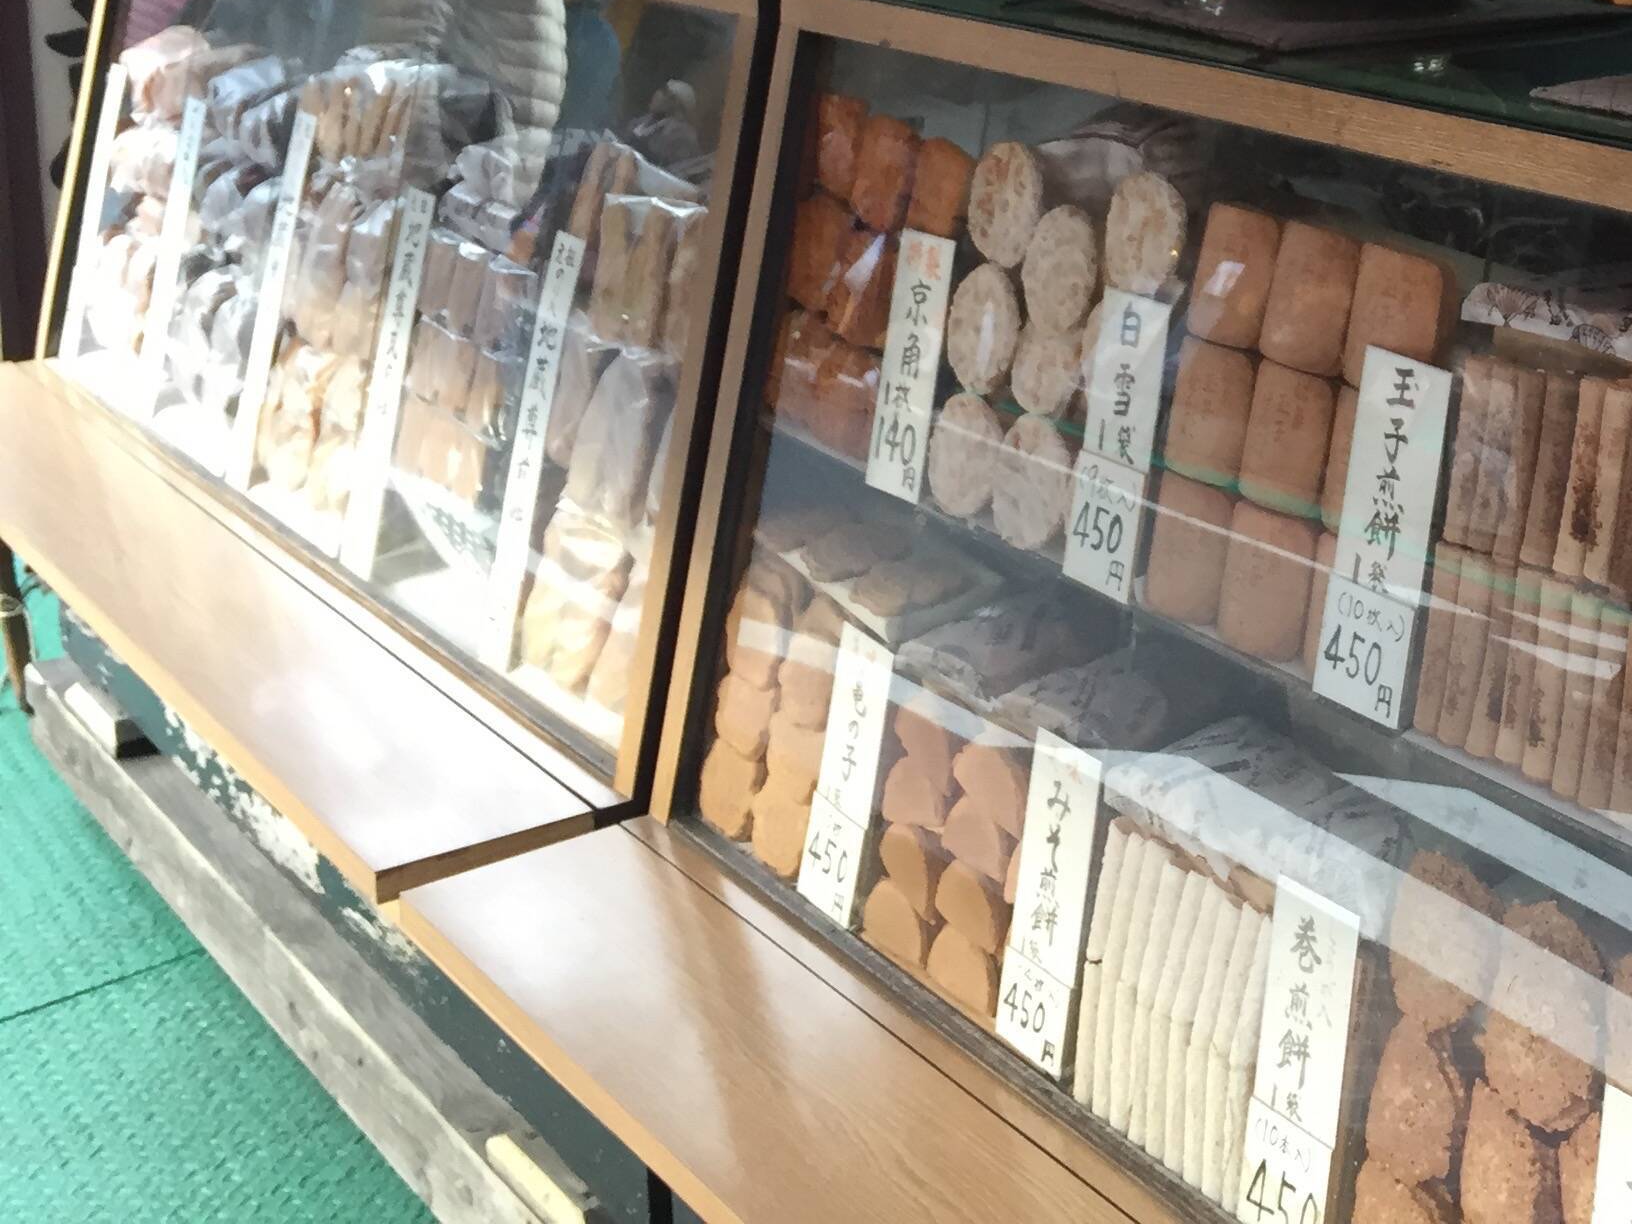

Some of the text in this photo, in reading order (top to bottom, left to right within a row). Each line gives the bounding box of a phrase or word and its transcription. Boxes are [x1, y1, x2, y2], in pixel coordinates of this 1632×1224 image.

[1364, 367, 1419, 562] 玉子煎餅
[1072, 500, 1126, 592] 450円
[1323, 623, 1394, 719] 450円
[1030, 780, 1071, 947] みそ煎餅
[1003, 981, 1056, 1068] 450円
[1277, 915, 1321, 1089] 巻煎餅
